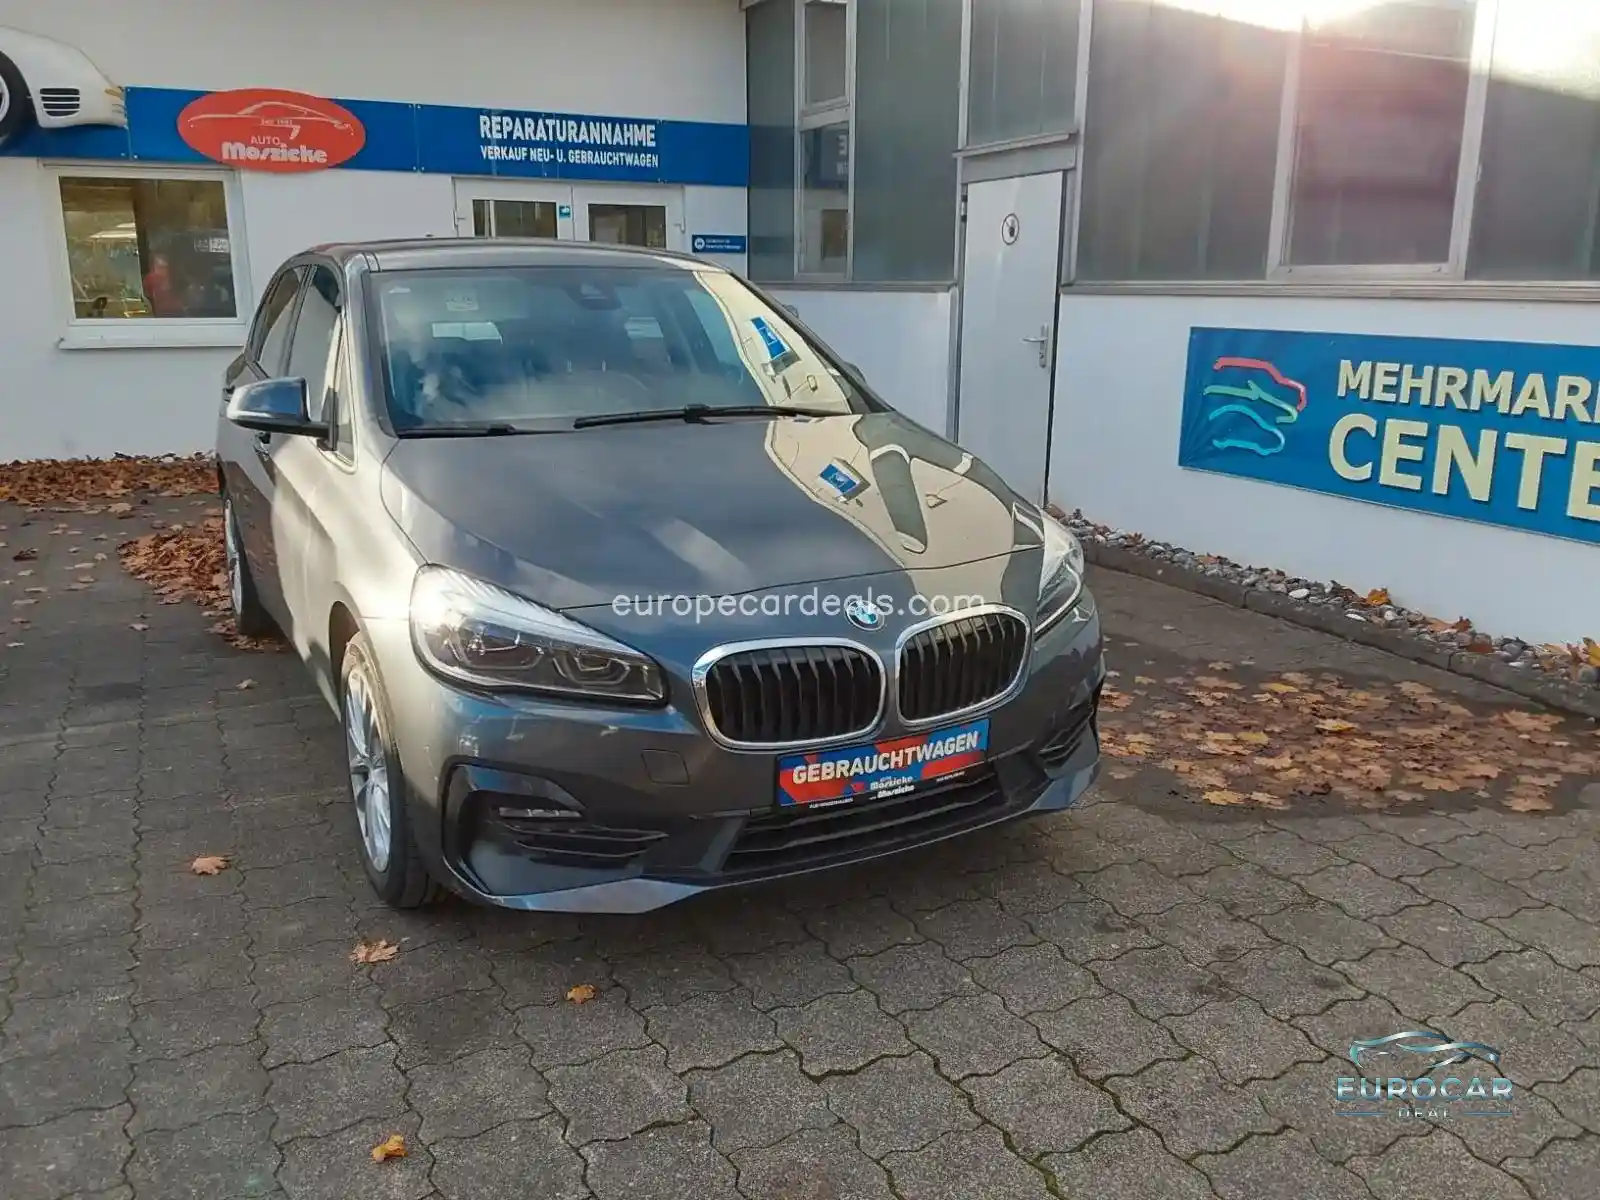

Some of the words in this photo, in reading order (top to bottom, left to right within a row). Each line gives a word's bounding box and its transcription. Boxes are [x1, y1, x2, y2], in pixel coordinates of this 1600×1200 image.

[251, 135, 280, 145] AUTO
[479, 115, 656, 148] REPARATURANNAHME
[480, 145, 528, 161] VERKAUF
[529, 147, 554, 163] NEU-
[556, 149, 566, 163] U.
[568, 150, 659, 168] GEBRAUCHTWAGEN
[1337, 359, 1600, 424] MEHRMAR
[792, 730, 979, 784] GEBRAUCHTWAGEN
